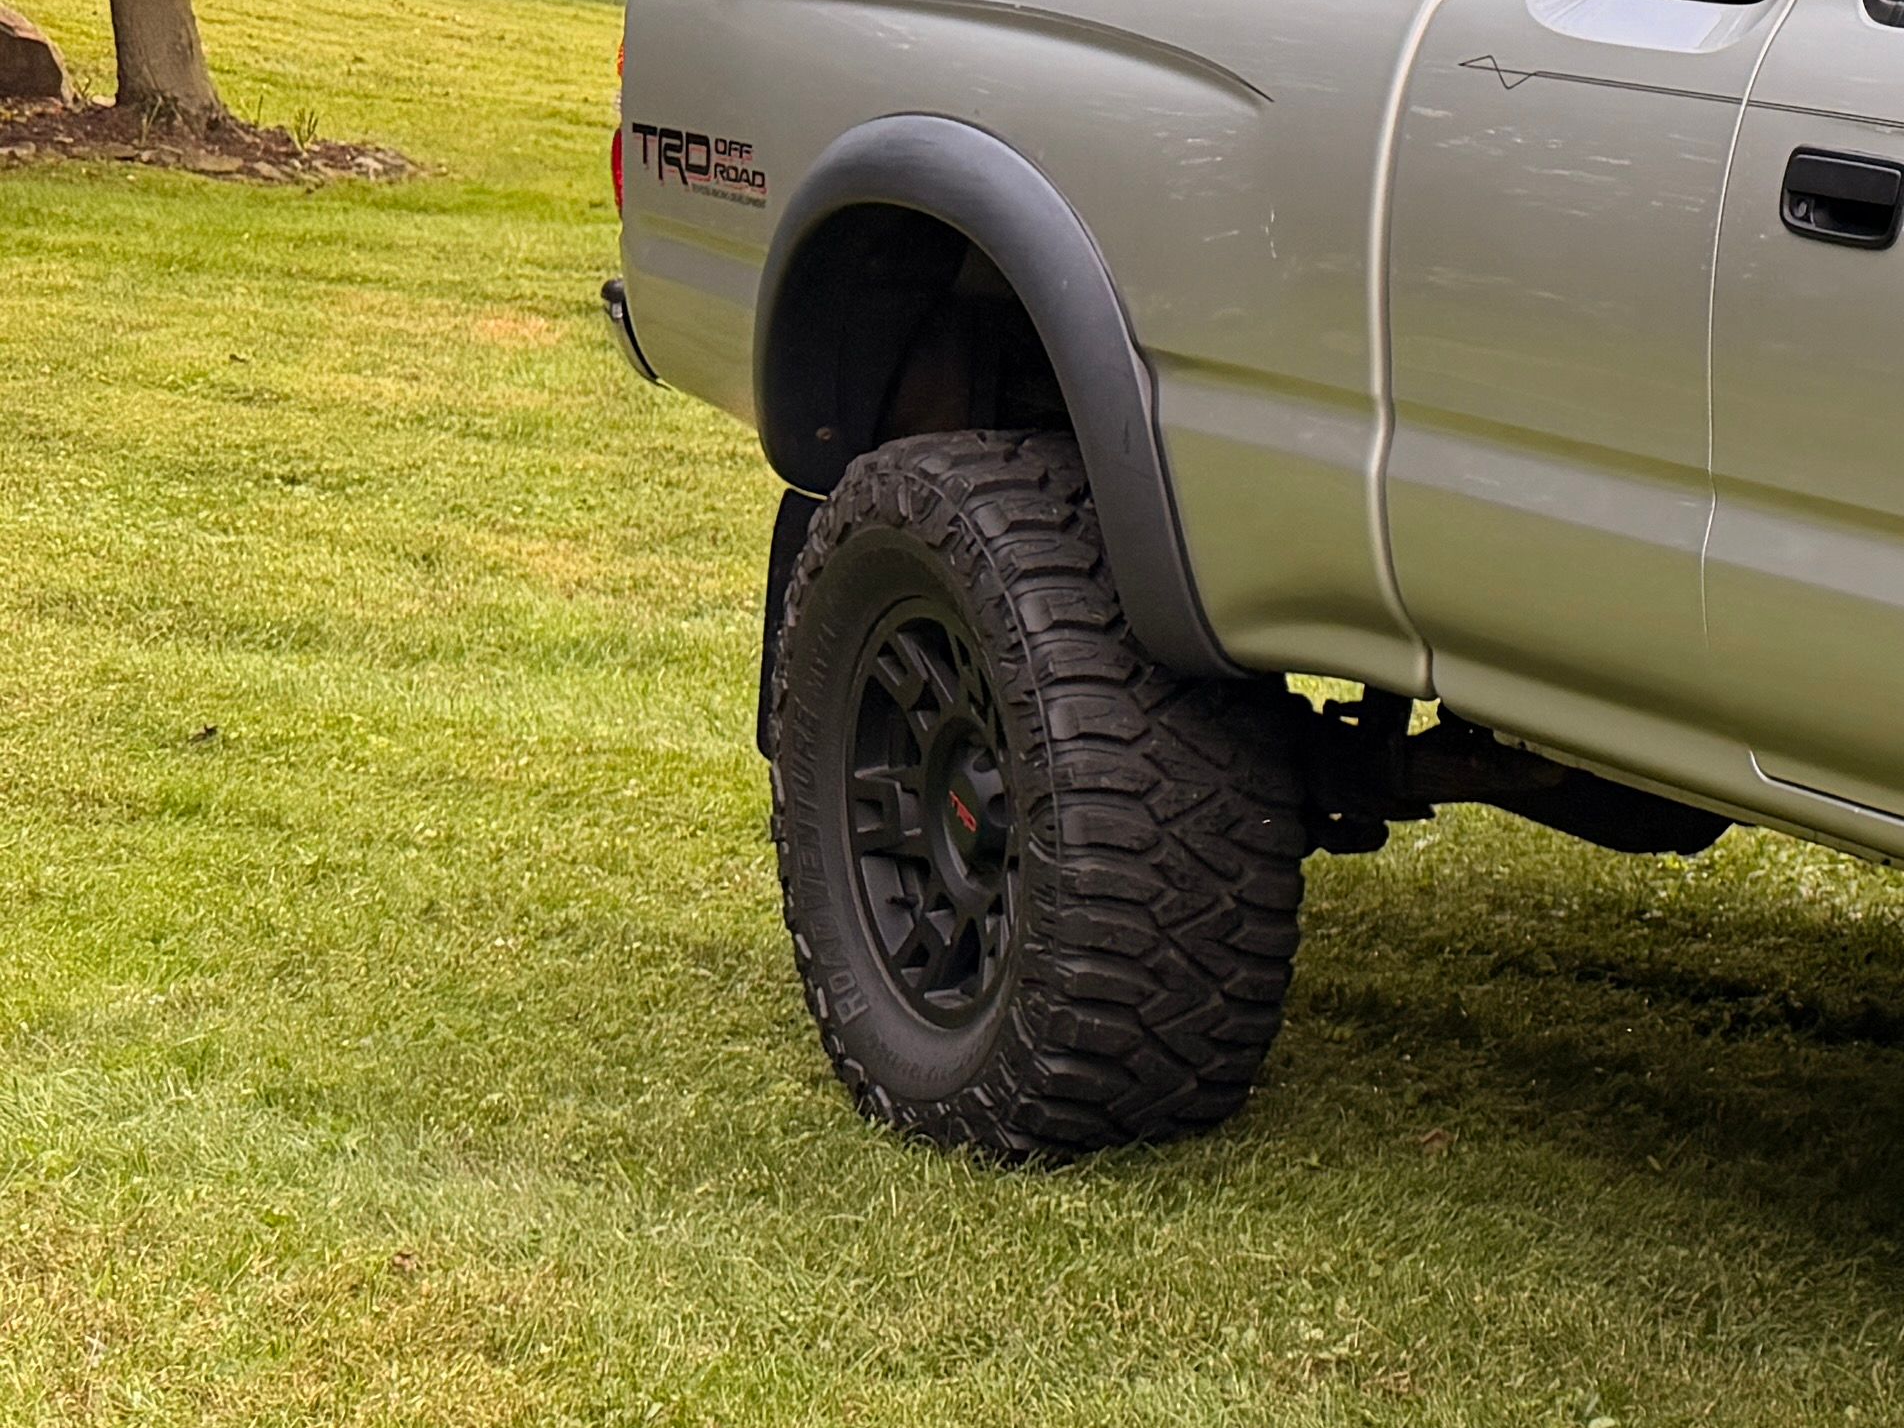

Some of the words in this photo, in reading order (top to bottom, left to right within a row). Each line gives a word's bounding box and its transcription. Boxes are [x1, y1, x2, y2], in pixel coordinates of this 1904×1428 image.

[632, 122, 711, 186] TRD
[714, 138, 753, 159] OFF
[714, 162, 766, 188] ROAD
